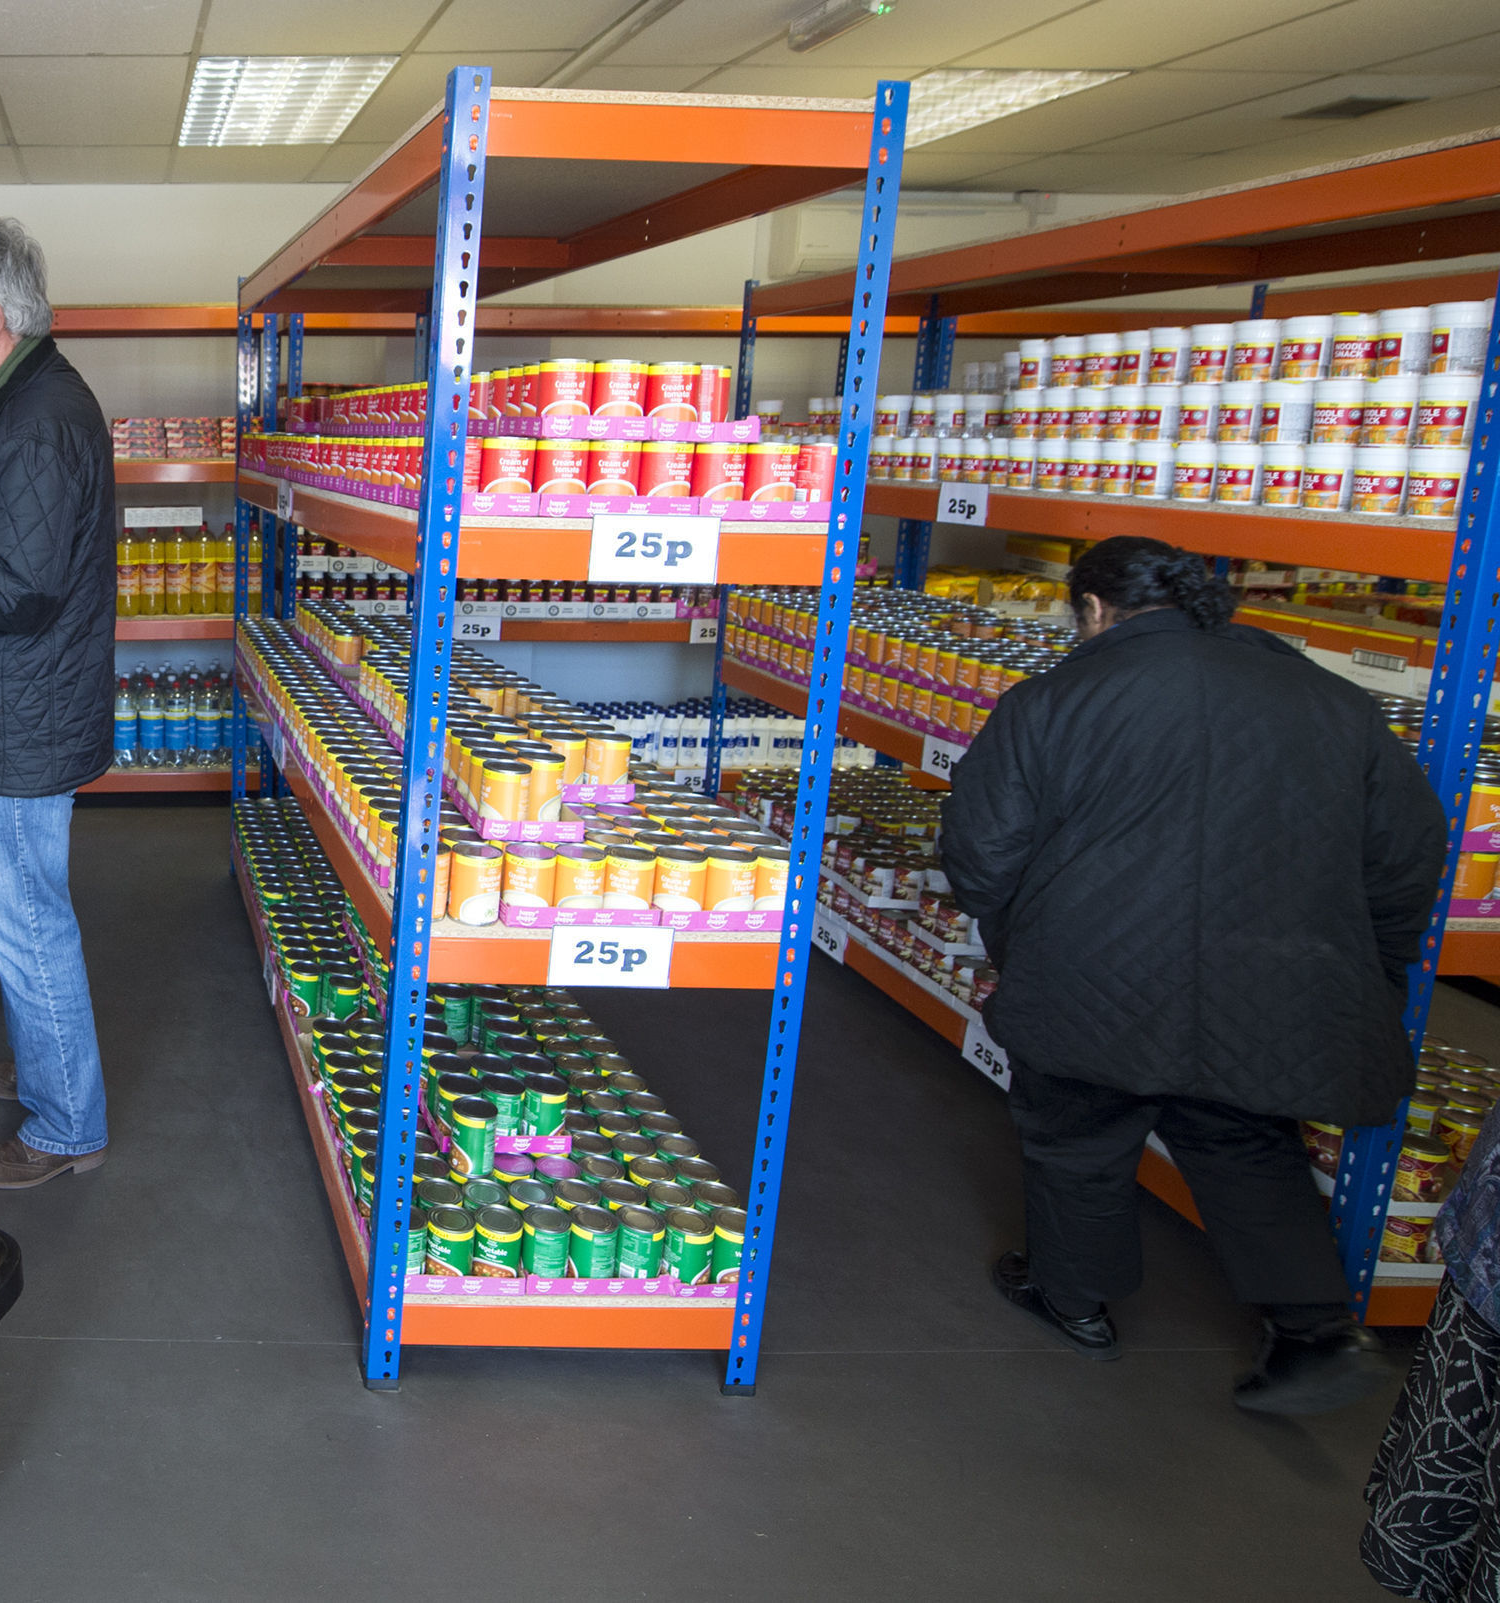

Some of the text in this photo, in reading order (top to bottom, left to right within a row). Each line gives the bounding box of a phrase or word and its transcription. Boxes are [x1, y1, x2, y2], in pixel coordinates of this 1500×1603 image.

[1335, 342, 1371, 351] NOODLE
[1334, 350, 1363, 358] SNACK
[554, 381, 585, 389] Cream of
[609, 381, 640, 389] Cream of
[661, 383, 692, 392] Cream of
[557, 388, 583, 396] tomato
[612, 388, 637, 396] tomato
[664, 390, 690, 398] tomato
[1364, 408, 1387, 418] ODLE
[1419, 408, 1441, 418] ODLE
[1364, 416, 1380, 425] ACK
[1418, 416, 1434, 425] ACK
[499, 458, 520, 466] Cream
[552, 459, 582, 467] Cream of
[598, 459, 629, 468] Cream of
[666, 462, 684, 470] Cream
[722, 462, 740, 470] Cream
[501, 465, 525, 473] tomato
[555, 466, 580, 474] tomato
[948, 498, 977, 518] 25p
[614, 531, 693, 566] 25p
[462, 624, 491, 638] 25p
[700, 627, 717, 638] 25
[818, 926, 838, 951] 25p
[573, 940, 648, 972] 25p
[974, 1042, 1004, 1076] 25p
[478, 1241, 508, 1256] Vegetable
